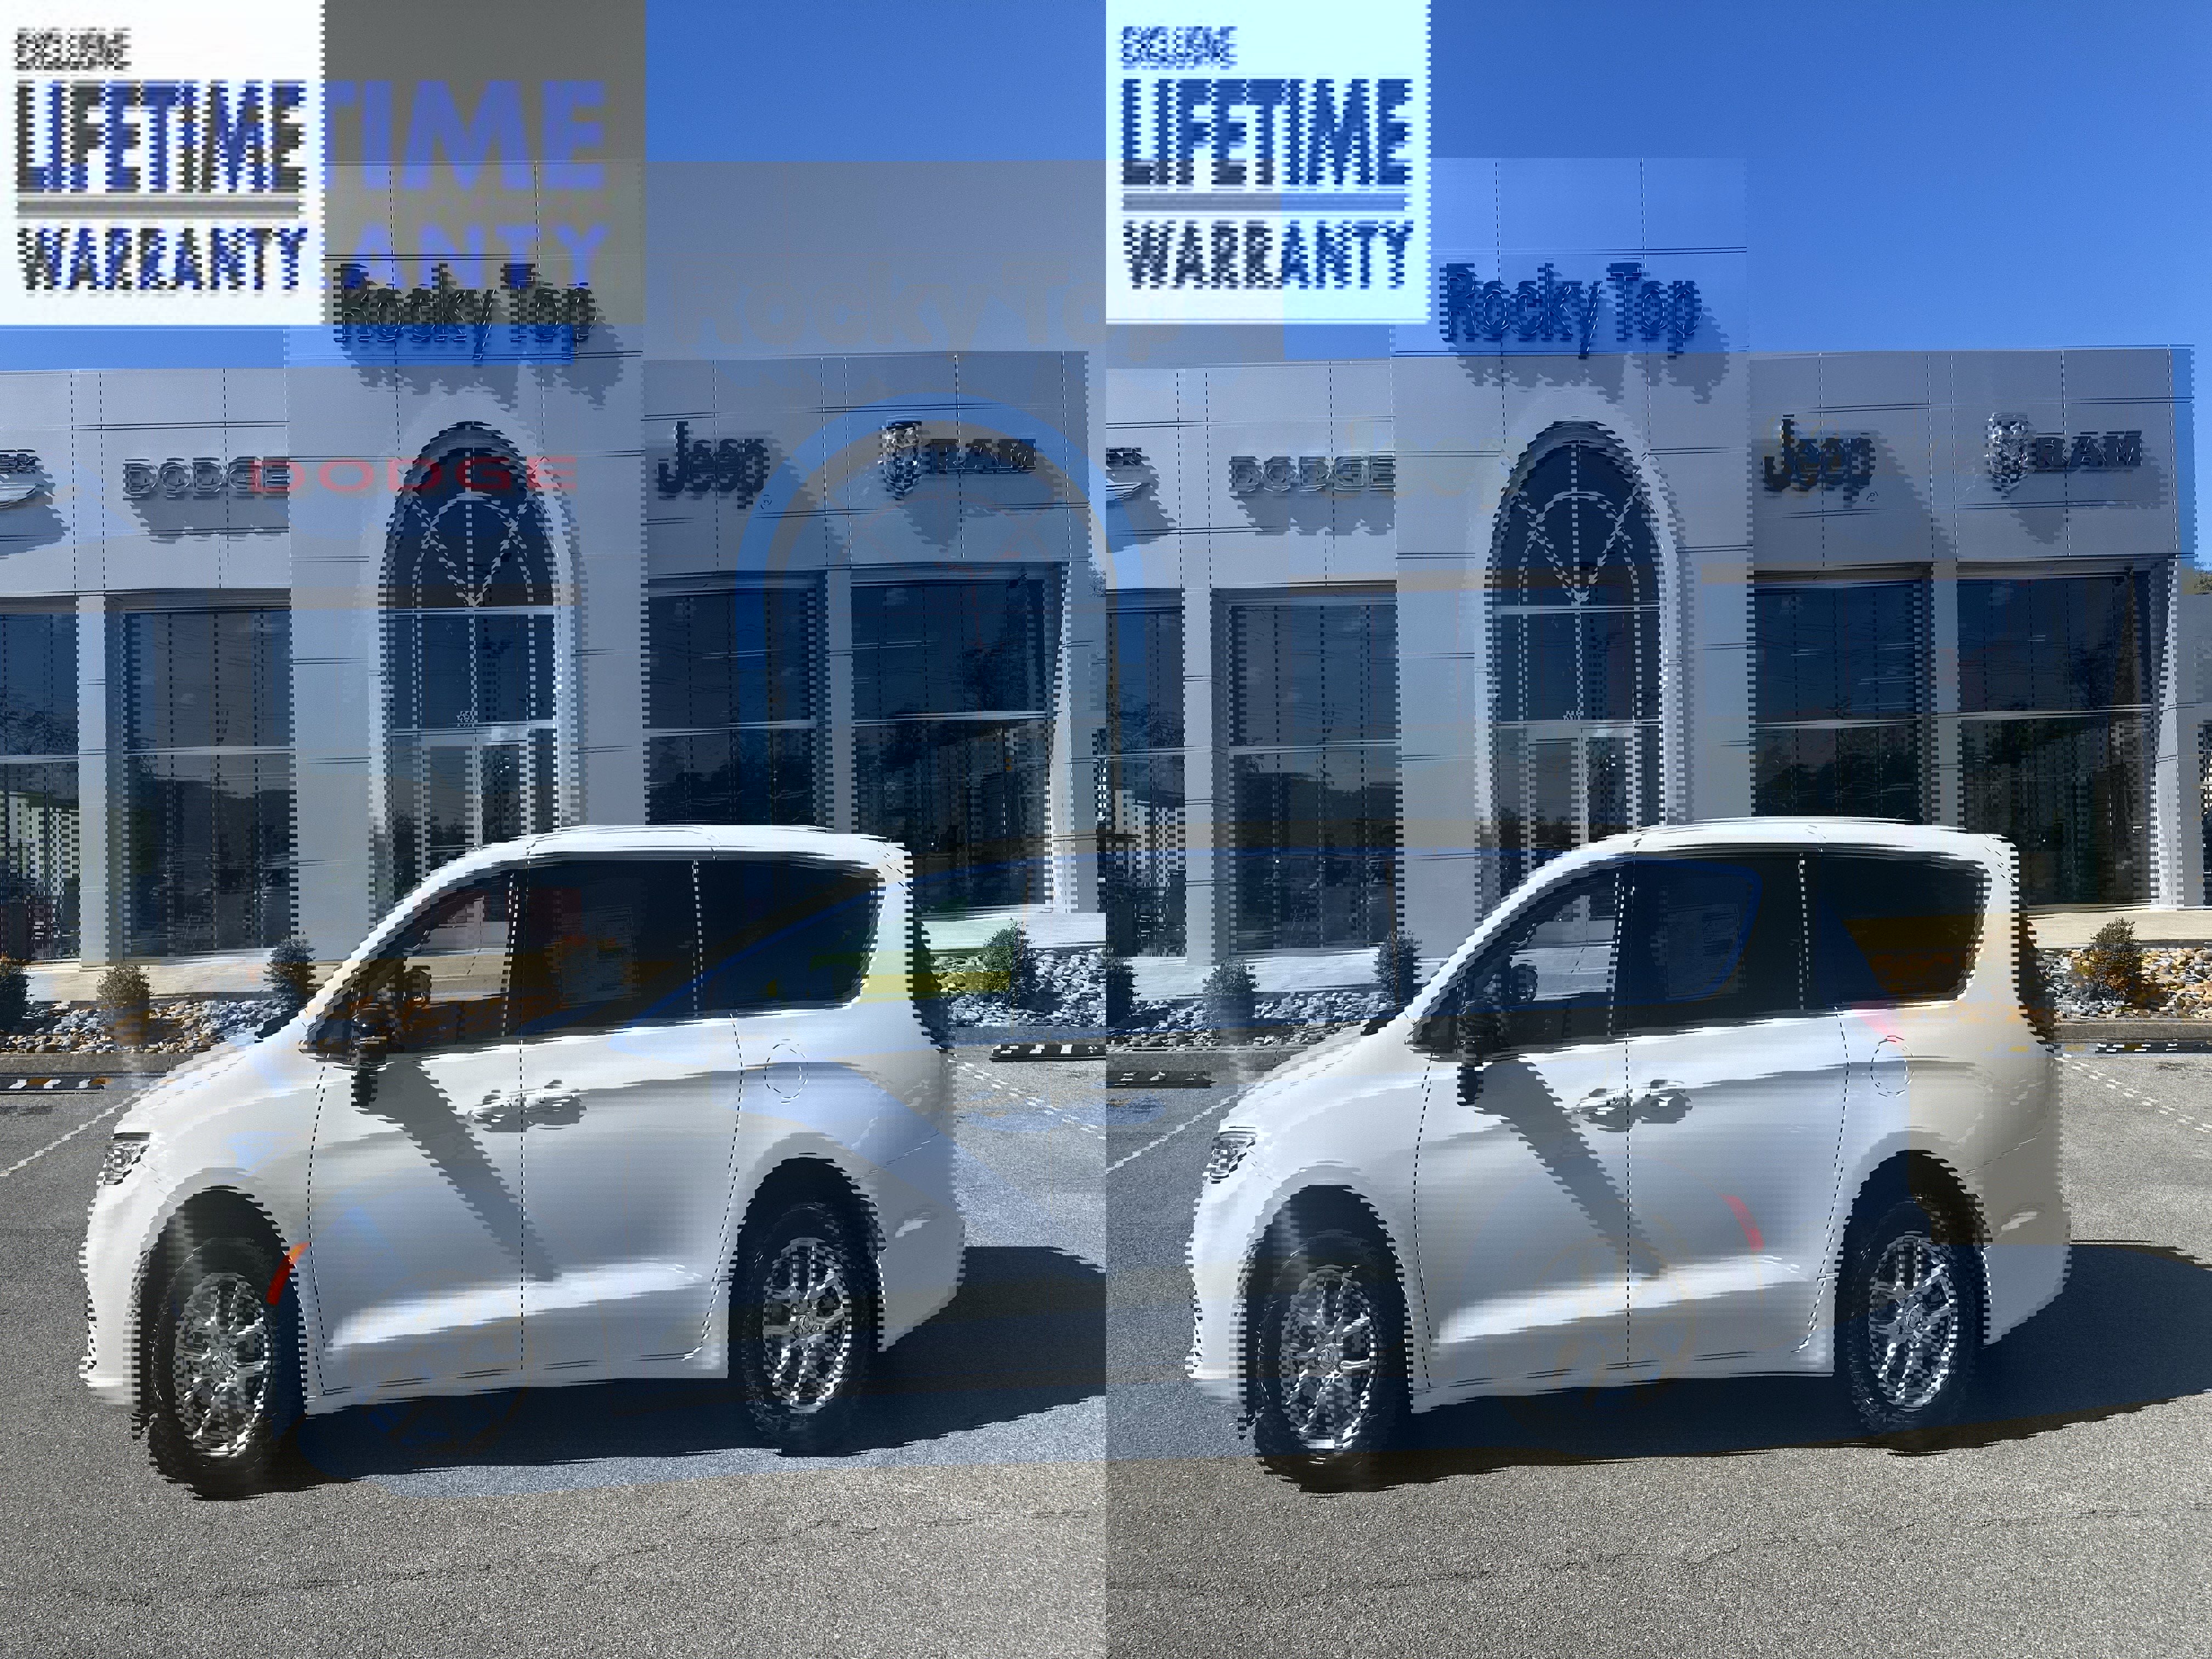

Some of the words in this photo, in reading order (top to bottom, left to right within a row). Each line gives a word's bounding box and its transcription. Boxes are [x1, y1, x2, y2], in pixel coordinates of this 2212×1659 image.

[332, 263, 498, 359] Rocky
[504, 263, 598, 357] Top
[1439, 263, 1605, 359] Rocky
[1606, 262, 1703, 359] Top
[123, 456, 290, 495] DODGE
[658, 421, 770, 508] Jeep
[936, 438, 1036, 473] RAM
[1228, 456, 1396, 493] DODGE
[1762, 414, 1877, 508] Jeep
[2034, 432, 2144, 473] RAM
